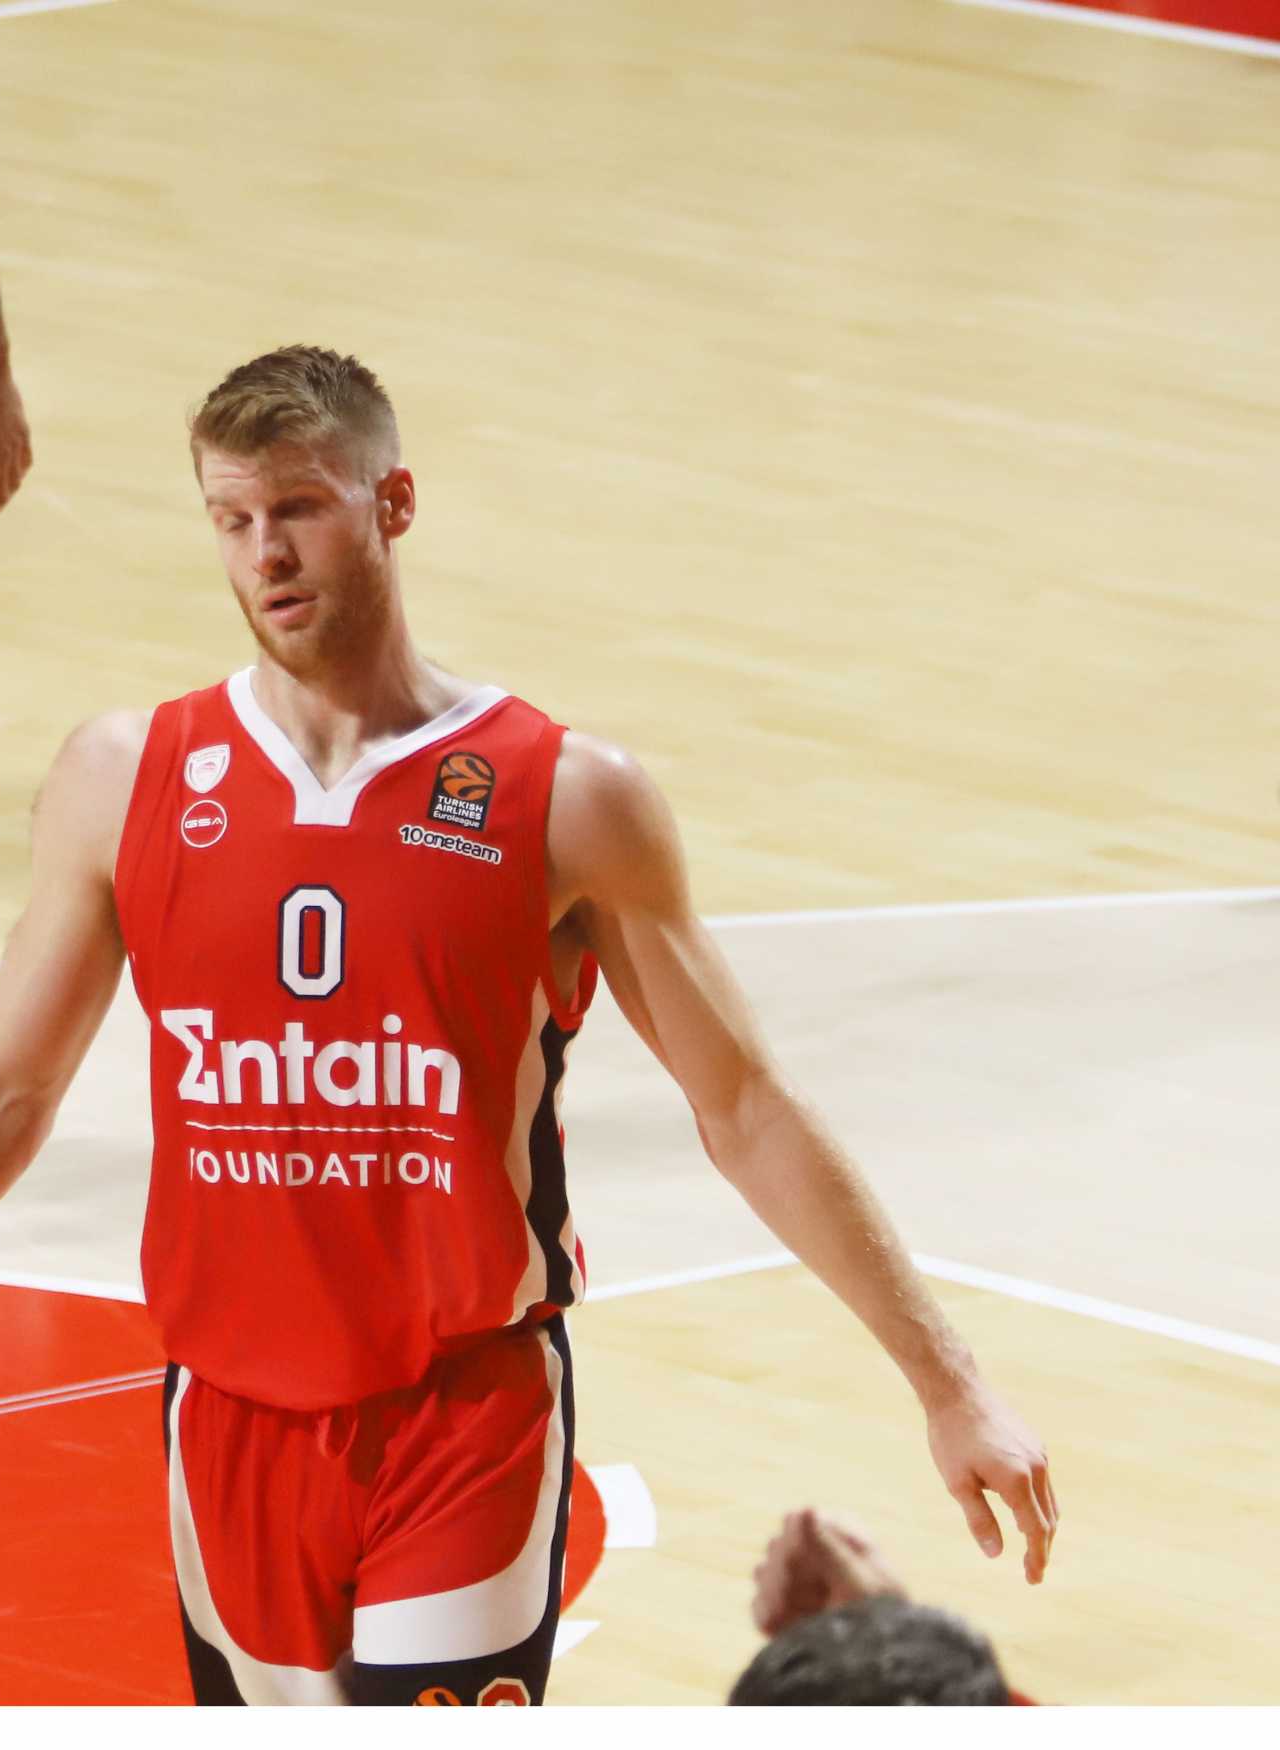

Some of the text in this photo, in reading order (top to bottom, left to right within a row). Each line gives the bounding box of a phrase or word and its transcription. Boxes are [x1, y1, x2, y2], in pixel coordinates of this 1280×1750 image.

[435, 803, 482, 820] AIRLINES
[437, 795, 484, 812] TURKISH
[184, 816, 224, 829] GSA
[276, 883, 347, 1000] 0
[189, 1147, 452, 1194] OUNDATION
